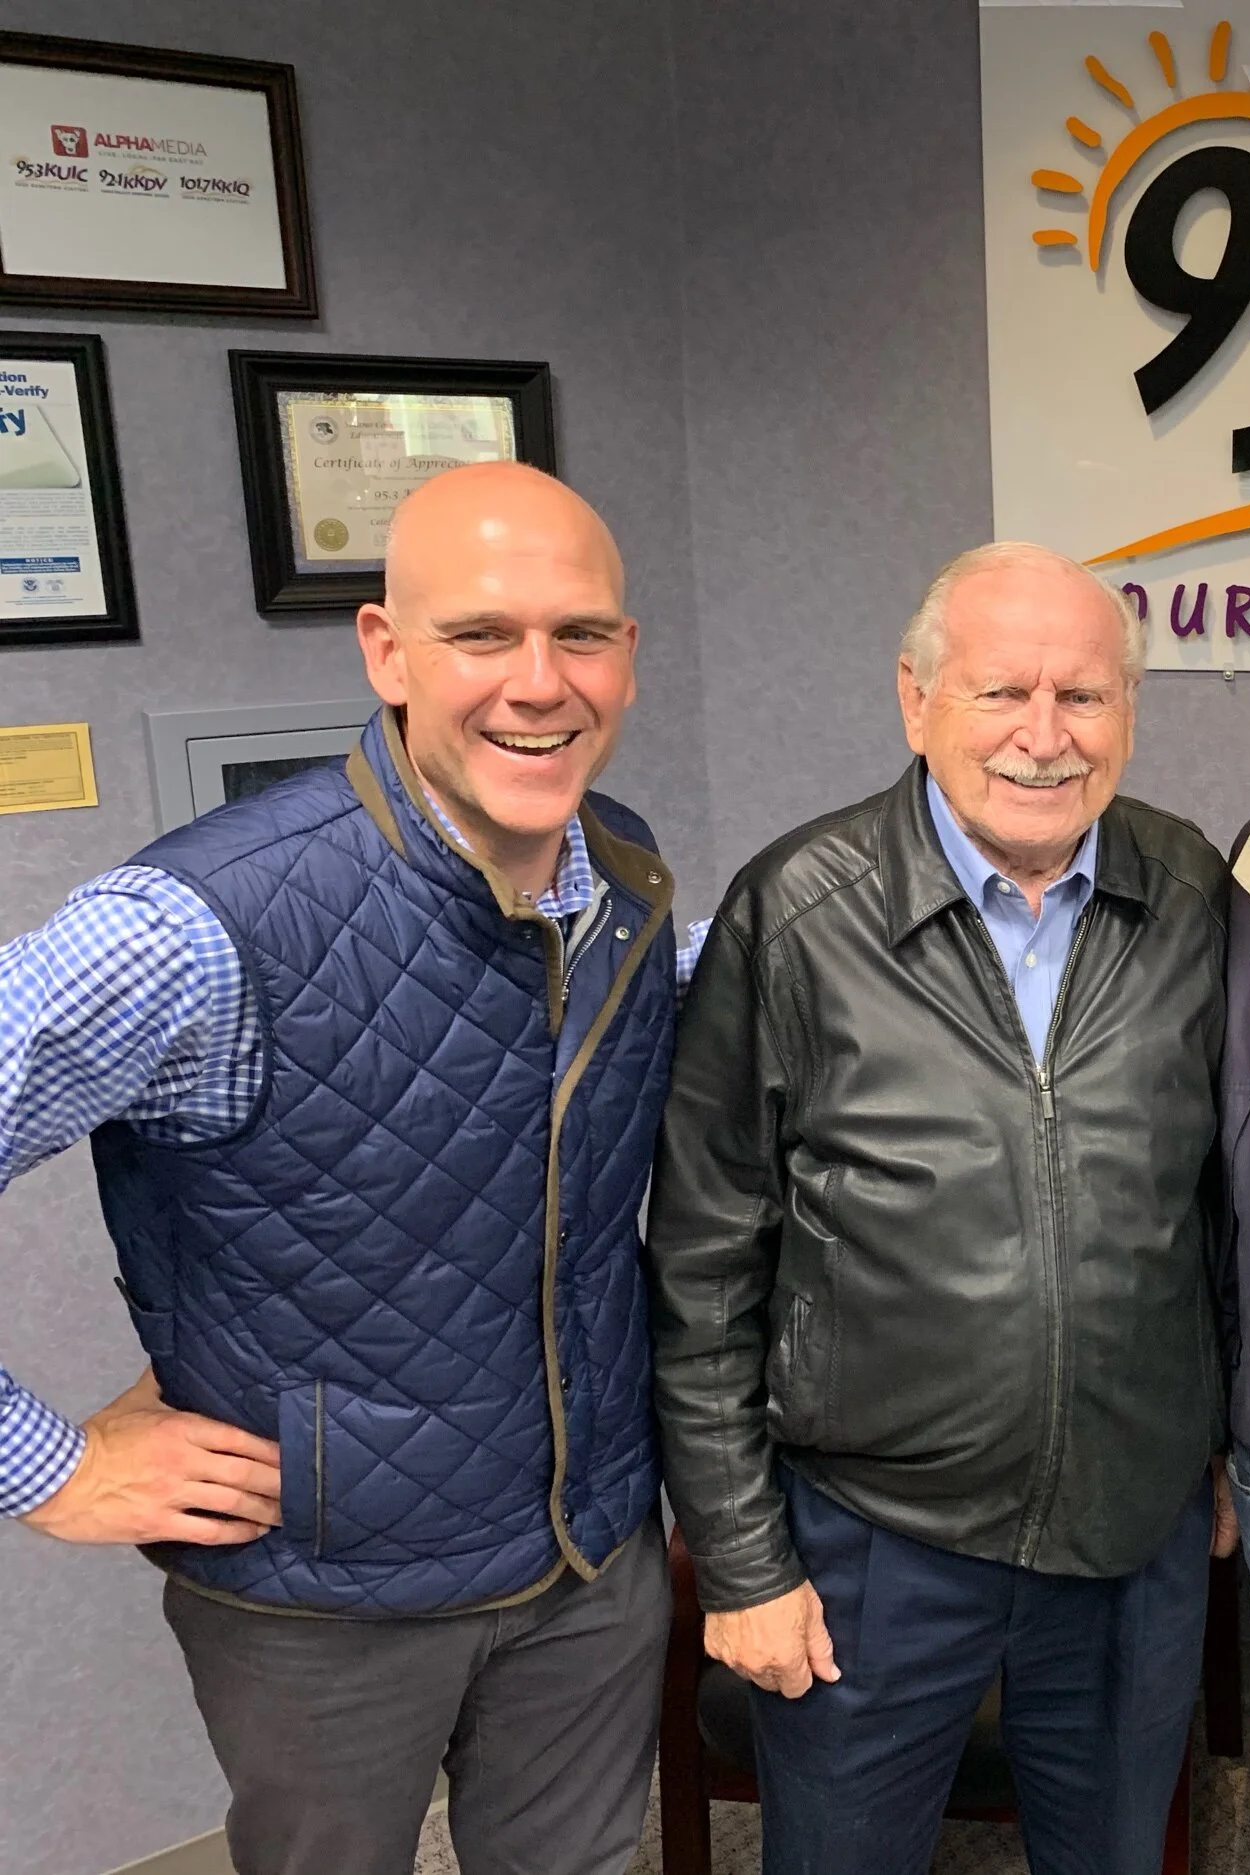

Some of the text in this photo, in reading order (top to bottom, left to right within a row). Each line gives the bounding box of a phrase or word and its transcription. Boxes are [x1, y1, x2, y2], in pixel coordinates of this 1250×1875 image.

[0, 385, 49, 399] -Verify
[389, 458, 402, 473] of
[405, 456, 472, 472] Apprecia
